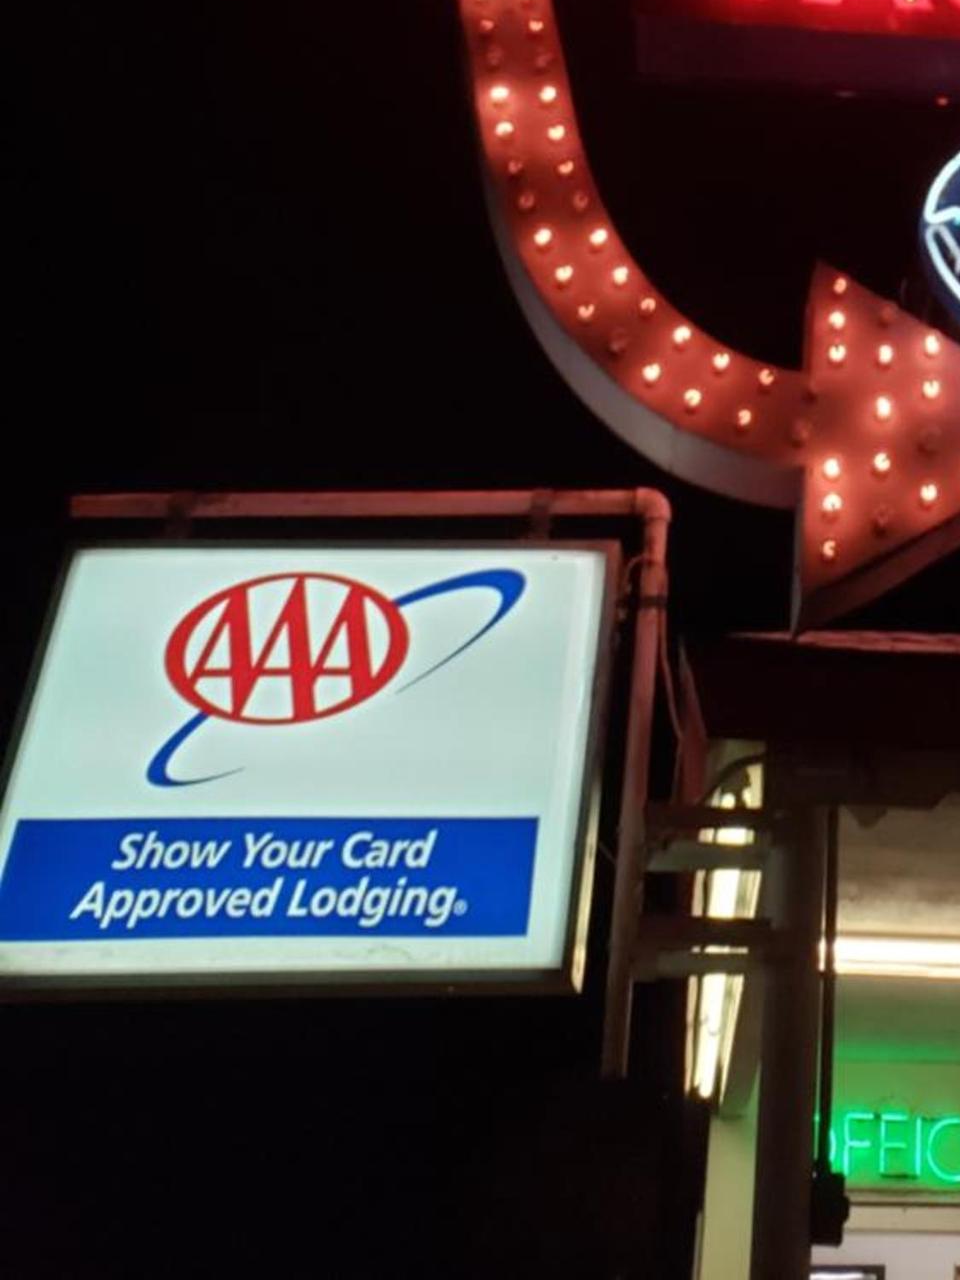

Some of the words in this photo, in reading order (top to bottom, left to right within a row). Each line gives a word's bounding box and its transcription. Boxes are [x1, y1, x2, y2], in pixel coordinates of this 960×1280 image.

[172, 573, 400, 723] AAA
[111, 832, 230, 870] Show
[242, 832, 328, 869] Your
[340, 830, 438, 869] Card
[71, 879, 285, 928] Approved
